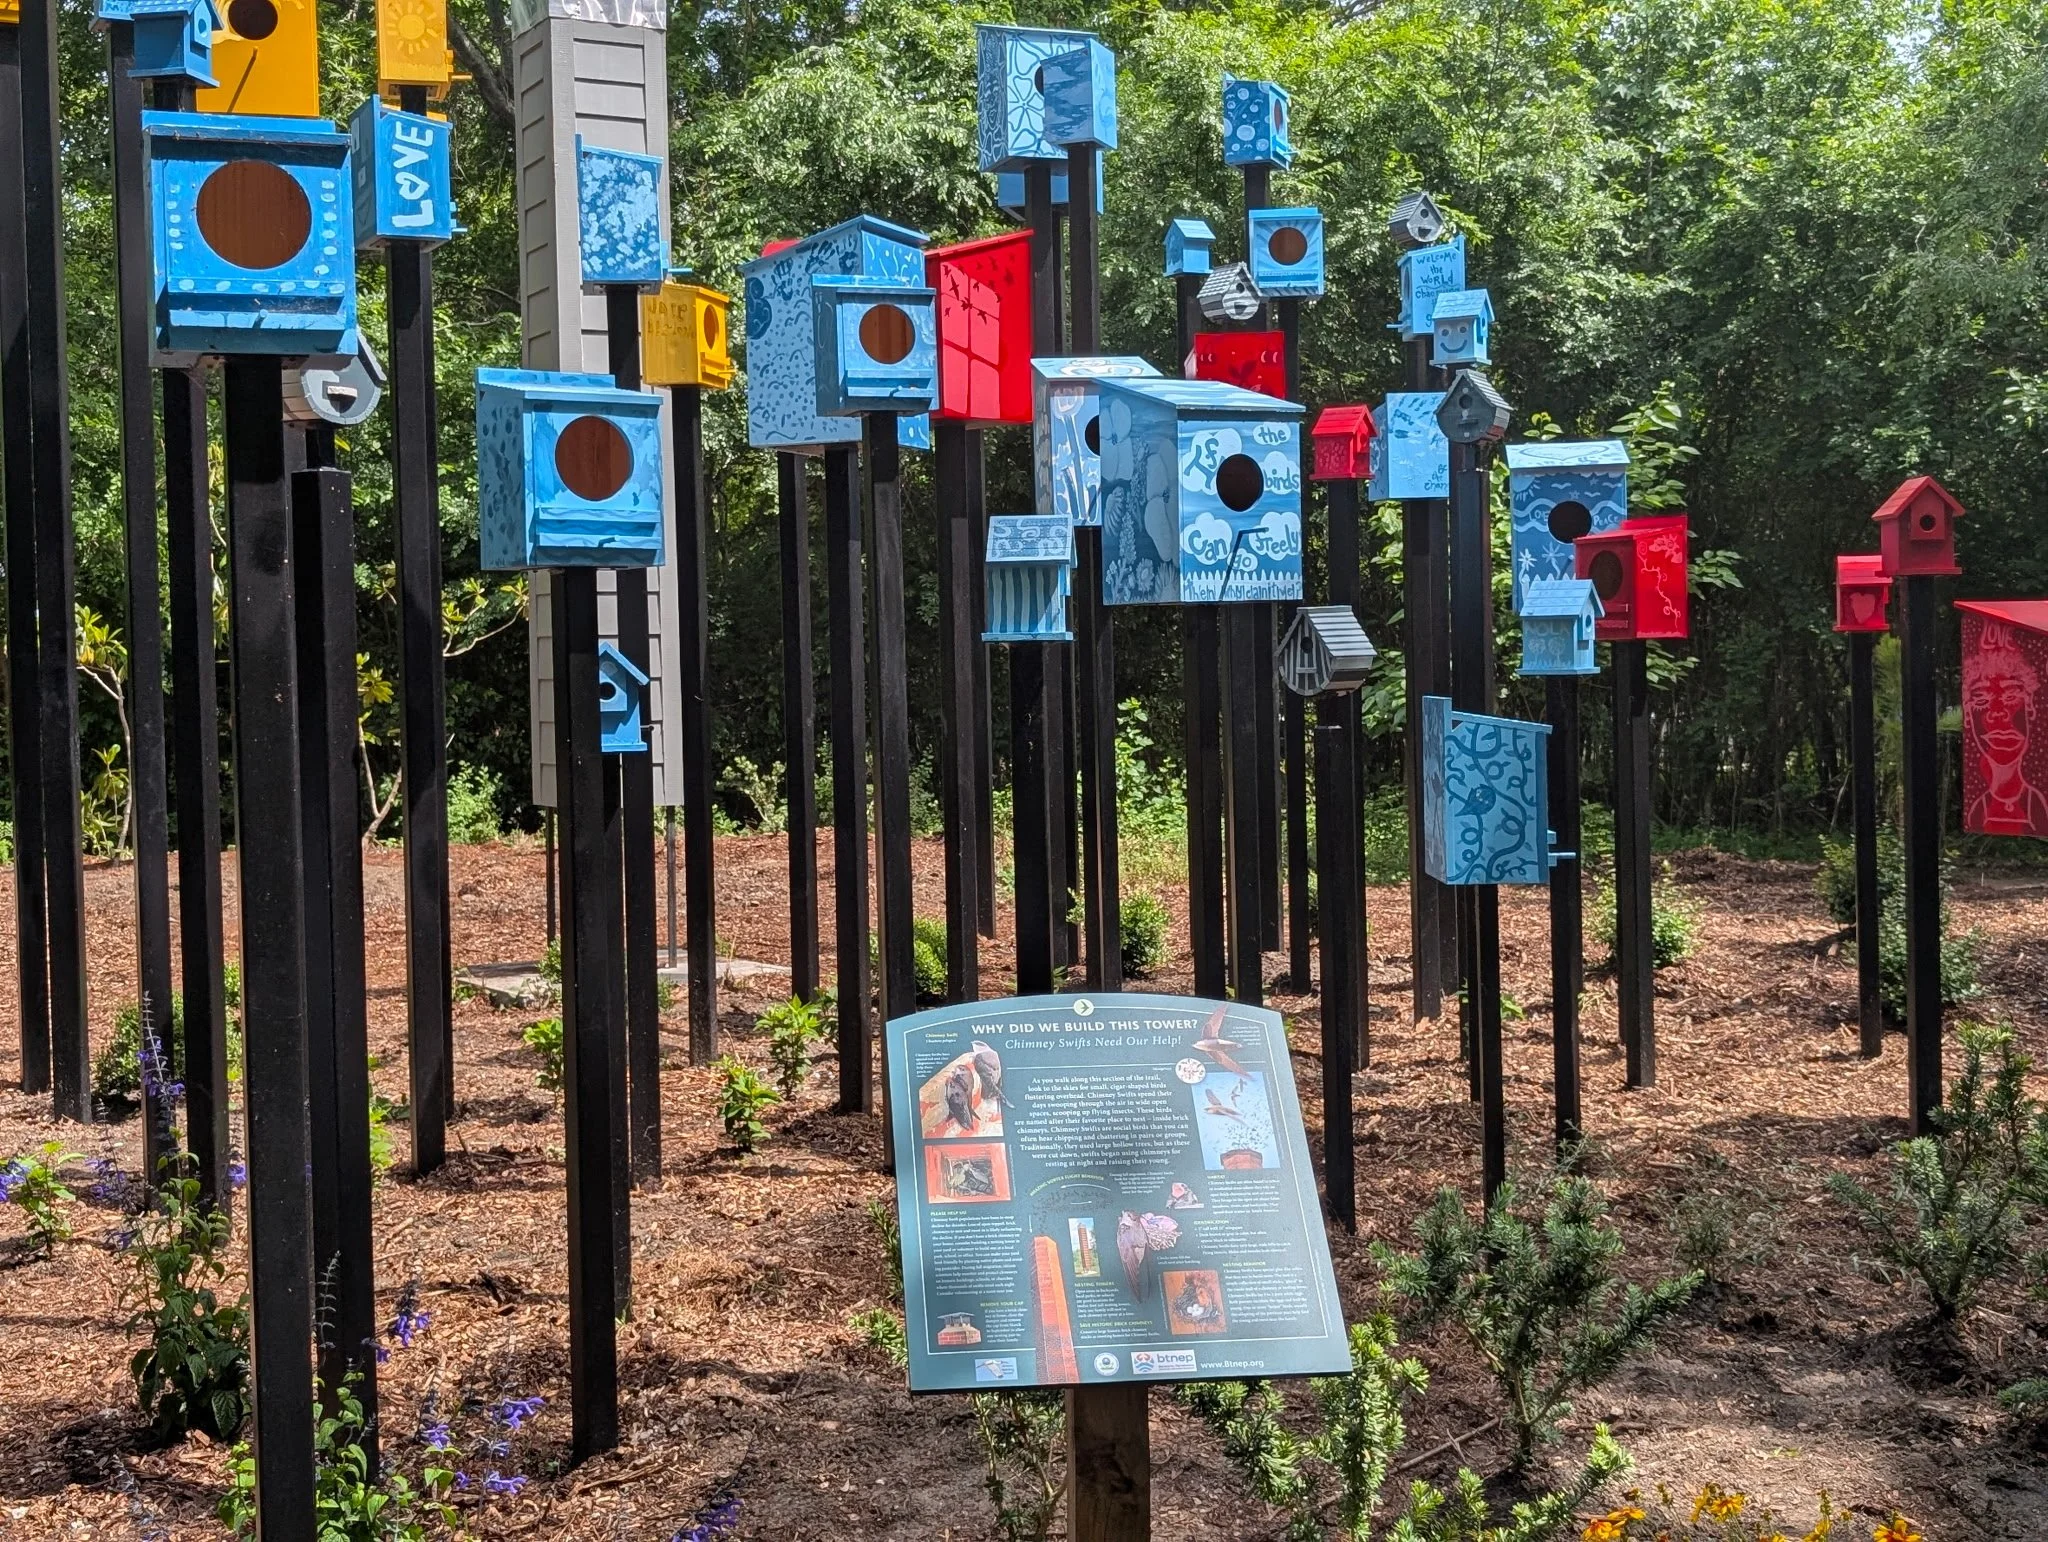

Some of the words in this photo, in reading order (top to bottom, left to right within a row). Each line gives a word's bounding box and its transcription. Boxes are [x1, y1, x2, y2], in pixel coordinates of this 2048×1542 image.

[392, 121, 434, 228] LOVE
[1430, 265, 1443, 275] the
[1258, 426, 1286, 444] the
[1264, 467, 1299, 490] birds
[1982, 622, 2016, 650] LOVE
[971, 1024, 1004, 1034] WHY
[1010, 1024, 1034, 1033] DID
[1038, 1022, 1060, 1032] WE
[1065, 1021, 1105, 1032] BUILD
[1109, 1020, 1140, 1030] THIS
[1144, 1019, 1198, 1030] TOWER?
[1005, 1039, 1055, 1051] Chimney
[1059, 1038, 1091, 1050] Swifts
[1094, 1037, 1122, 1047] Need
[1127, 1036, 1148, 1046] Our
[1153, 1036, 1181, 1048] Help!
[1157, 1353, 1193, 1363] btnep
[1200, 1360, 1264, 1369] www.Btnep.org
